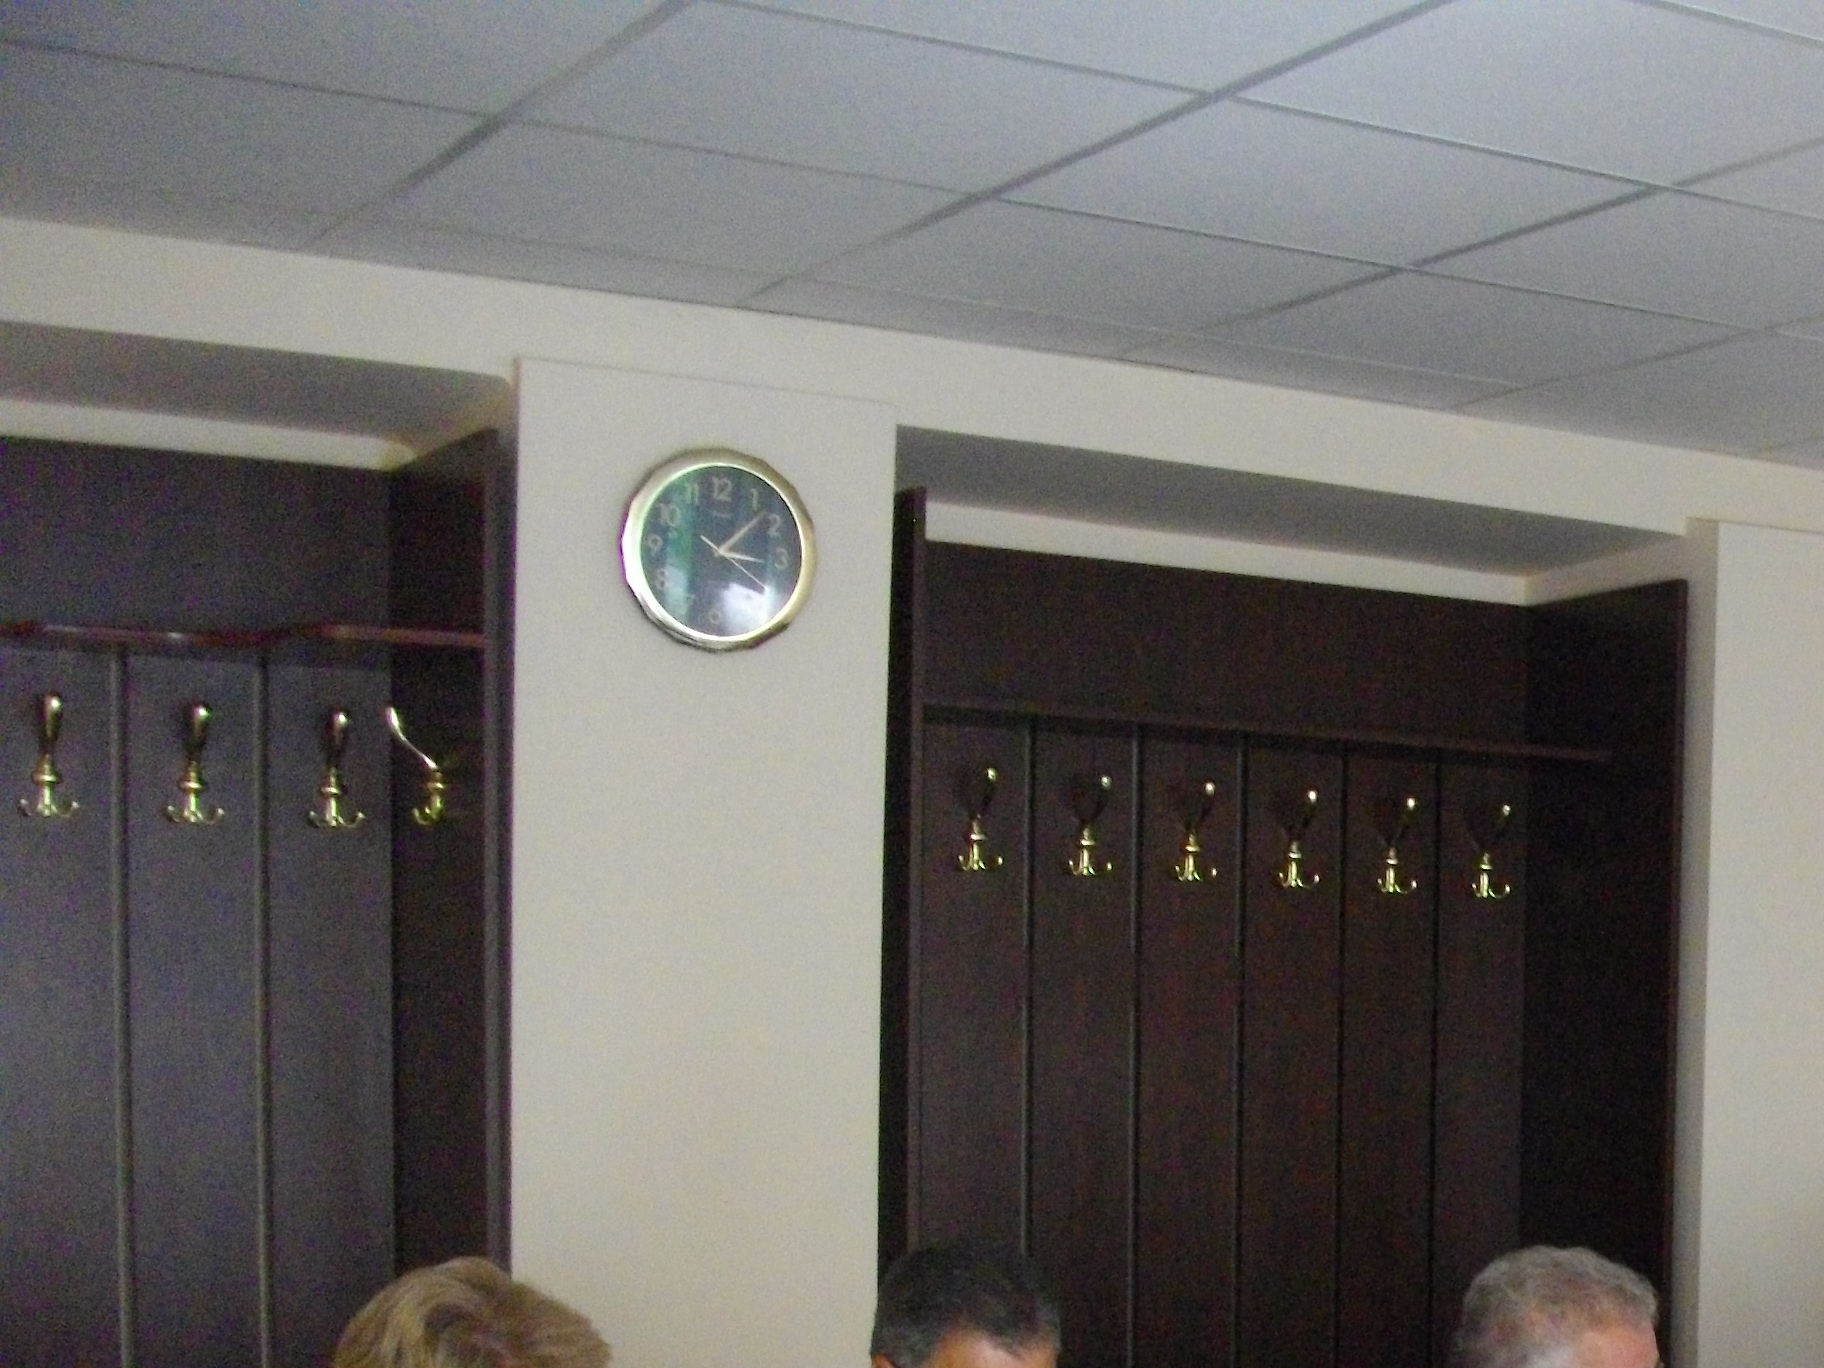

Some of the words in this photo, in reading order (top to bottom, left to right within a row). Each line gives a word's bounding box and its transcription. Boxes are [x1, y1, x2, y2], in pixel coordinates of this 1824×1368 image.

[711, 476, 733, 502] 12
[749, 488, 759, 511] 1
[657, 502, 681, 527] 10
[768, 513, 781, 537] 2
[646, 535, 663, 558] 9
[774, 548, 789, 570] 3
